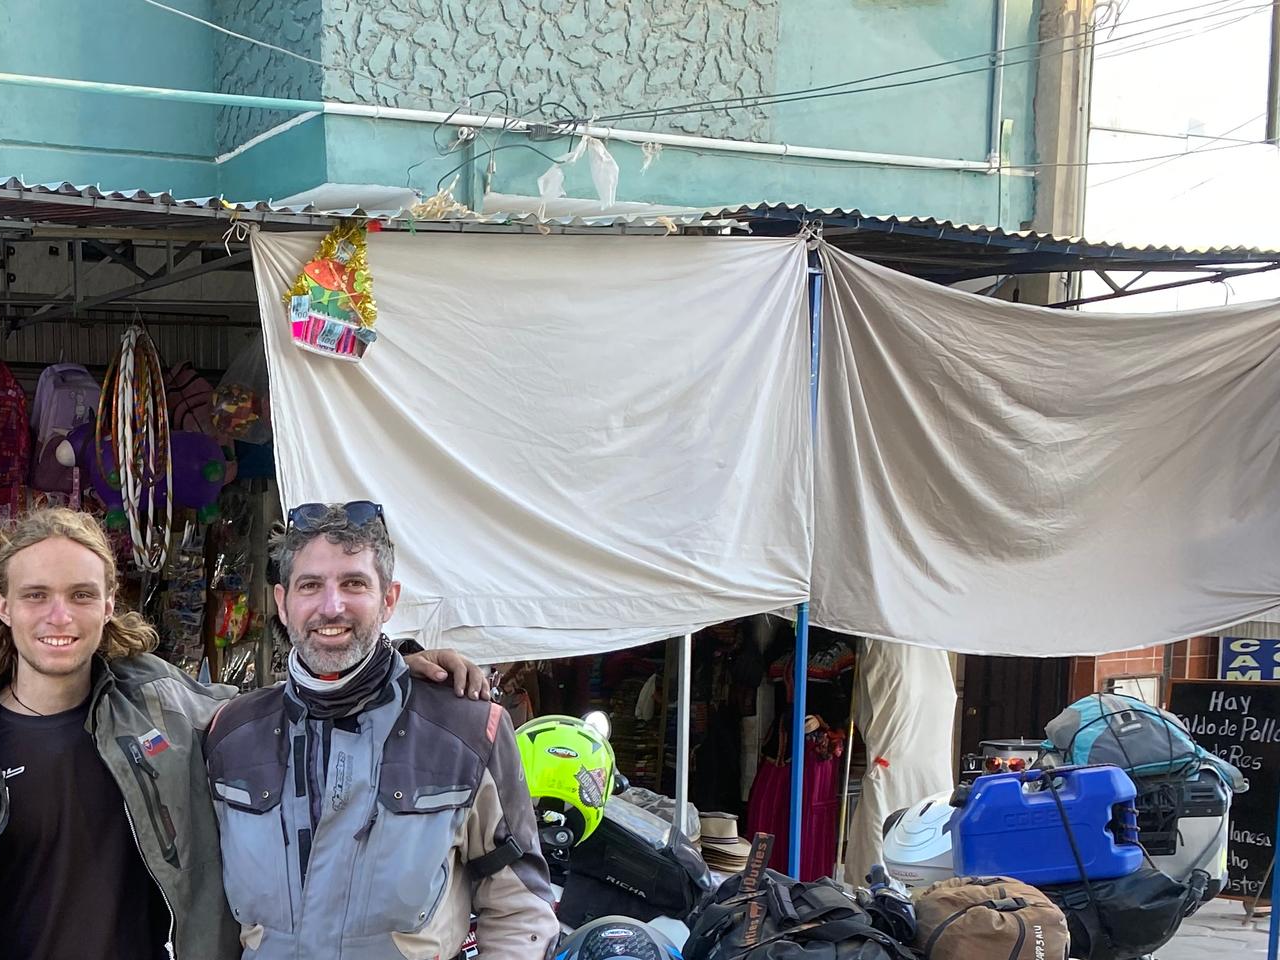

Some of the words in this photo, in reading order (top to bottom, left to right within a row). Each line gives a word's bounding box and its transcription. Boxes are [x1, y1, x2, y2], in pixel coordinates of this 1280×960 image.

[1209, 690, 1251, 715] Hay
[1178, 714, 1216, 735] aldo
[1218, 719, 1238, 737] de
[1229, 745, 1263, 770] Res
[606, 875, 646, 898] RICHA
[1033, 925, 1044, 939] ALU
